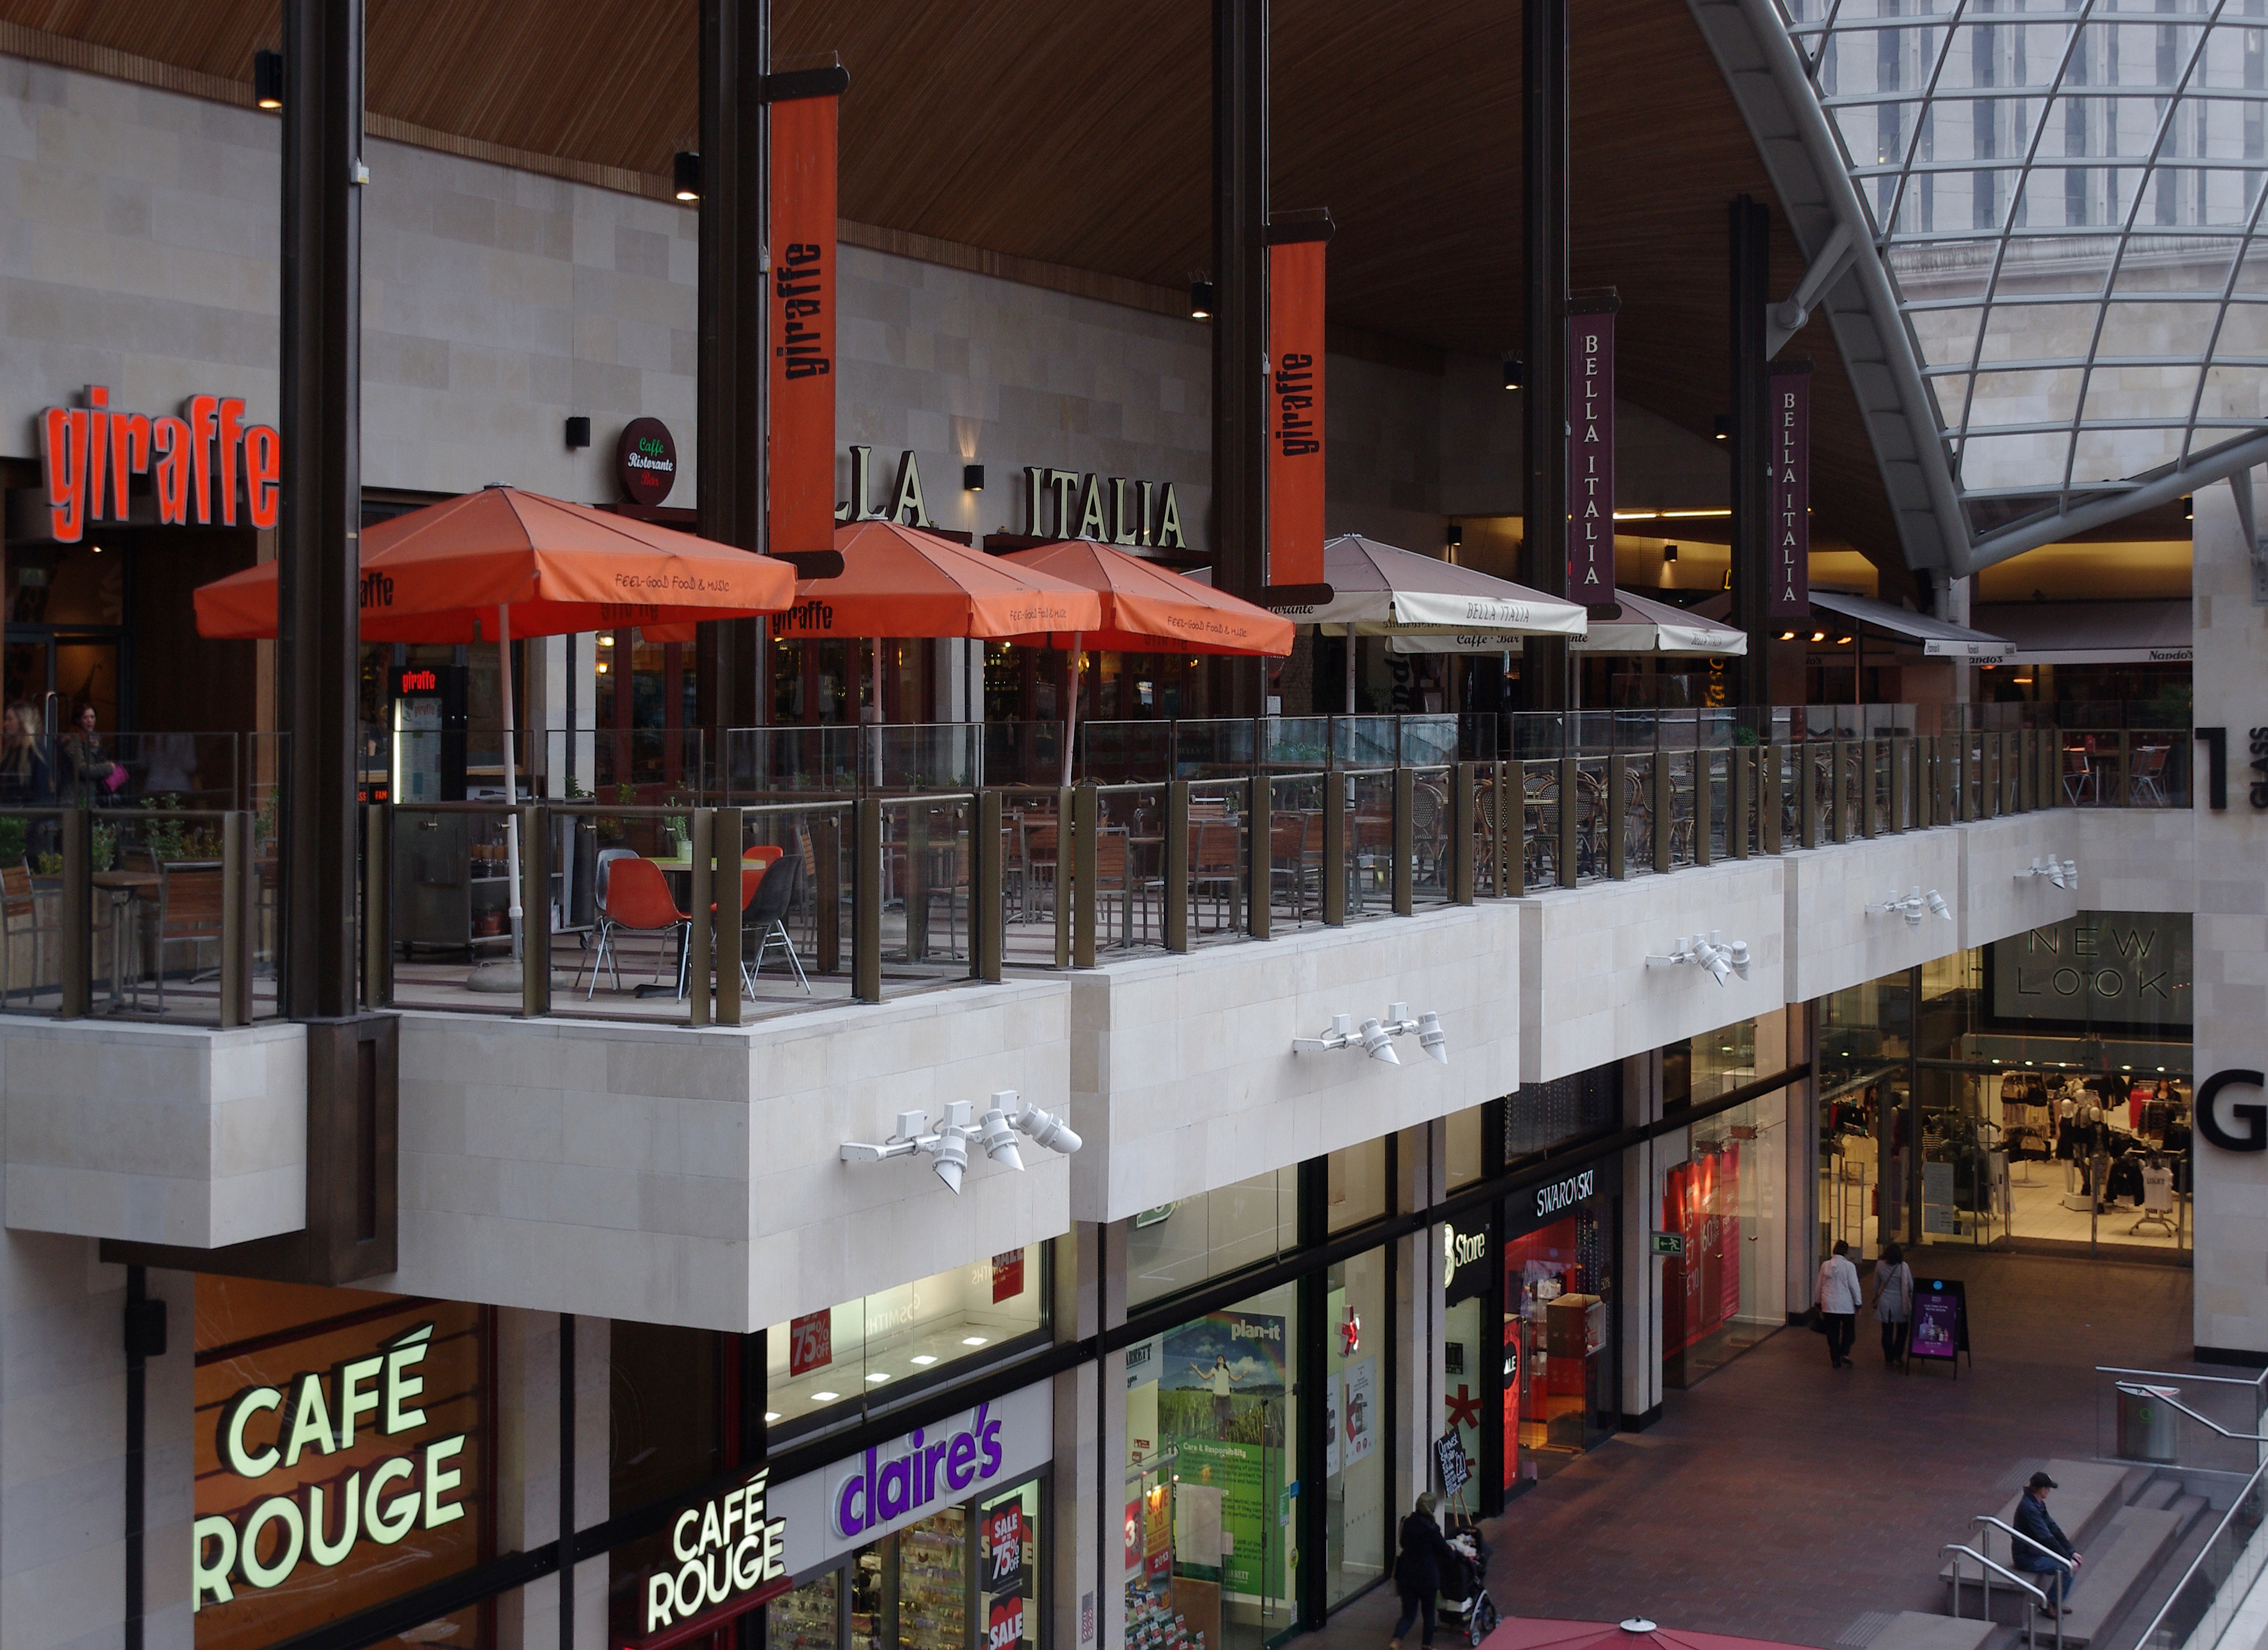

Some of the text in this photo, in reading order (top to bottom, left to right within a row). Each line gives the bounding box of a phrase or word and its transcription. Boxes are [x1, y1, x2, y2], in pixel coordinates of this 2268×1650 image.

[777, 242, 830, 380] giraffe
[1276, 353, 1319, 456] giraffe
[628, 452, 674, 472] Ristorante
[639, 437, 664, 456] Caffe
[1584, 334, 1601, 586] BELLA ITALIA
[43, 385, 280, 542] giraffe
[641, 471, 659, 486] Bar
[835, 446, 1186, 549] LA ITALIA
[1782, 393, 1797, 602] BELLA ITALIA
[698, 578, 706, 591] &
[1466, 602, 1530, 623] BELLA ITALIA
[1224, 624, 1230, 634] &
[1457, 636, 1519, 647] Caffe Bar
[2148, 649, 2193, 660] Nando's
[402, 670, 436, 694] giraffe
[2195, 727, 2226, 809] 1
[2030, 927, 2156, 957] NEW
[2018, 967, 2168, 999] LOOK
[2195, 1068, 2268, 1152] G
[1536, 1169, 1594, 1217] SWAROVSKI
[1456, 1232, 1485, 1268] Store
[793, 1319, 829, 1367] 75%
[1232, 1319, 1281, 1341] plan-it
[816, 1341, 829, 1359] OFF
[229, 1324, 434, 1478] CAFÉ
[1183, 1442, 1247, 1459] Care & Responsibility
[839, 1402, 1002, 1537] claire's
[672, 1466, 770, 1563] CAFÉ
[1148, 1489, 1169, 1515] SAVE
[193, 1434, 466, 1613] ROUGE
[994, 1513, 1018, 1538] SALE
[1002, 1534, 1007, 1543] UP
[1125, 1519, 1136, 1548] 3
[992, 1537, 1020, 1580] 75%
[1010, 1555, 1020, 1572] OFF
[1154, 1551, 1169, 1569] 2013
[647, 1519, 786, 1633] ROUGE
[989, 1612, 1023, 1650] SALE
